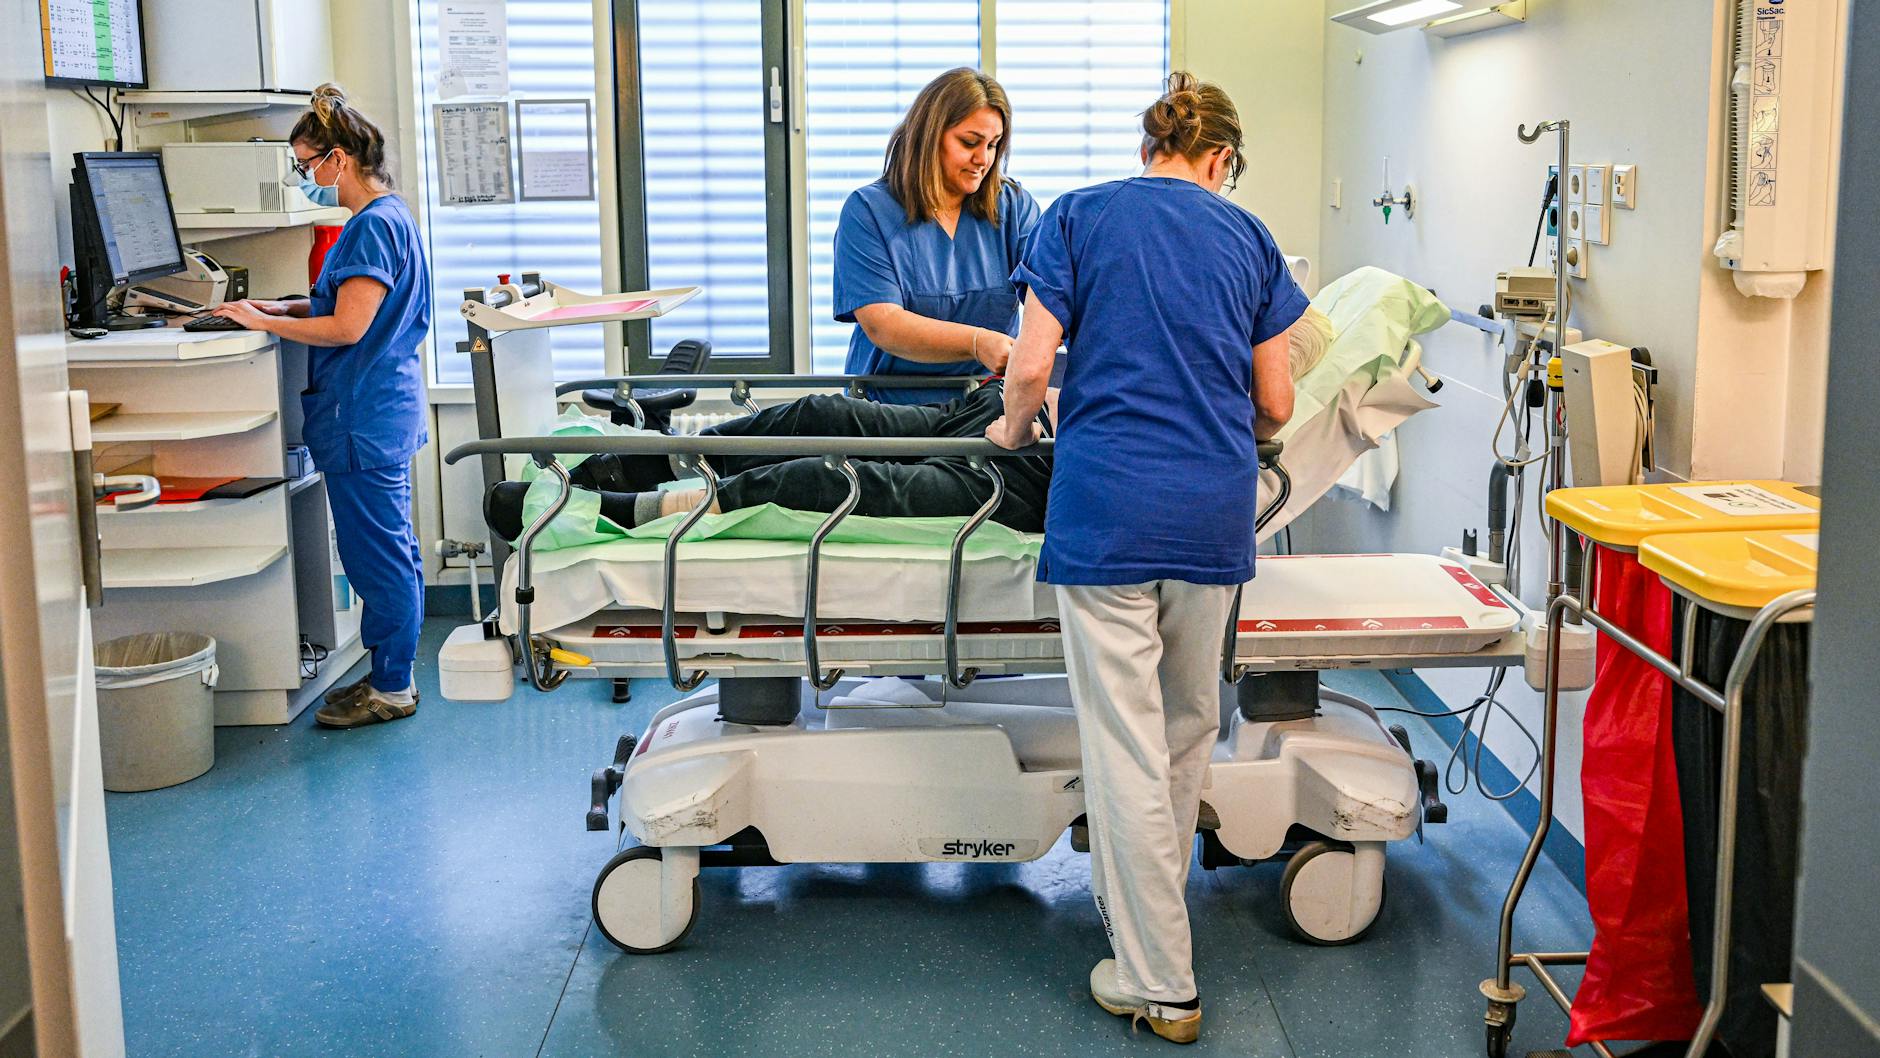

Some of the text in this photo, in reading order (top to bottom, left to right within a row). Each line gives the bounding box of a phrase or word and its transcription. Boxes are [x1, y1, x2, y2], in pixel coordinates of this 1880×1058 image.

[1757, 7, 1784, 15] SicSac
[942, 839, 1015, 858] stryker
[1096, 895, 1114, 937] Vivantes
